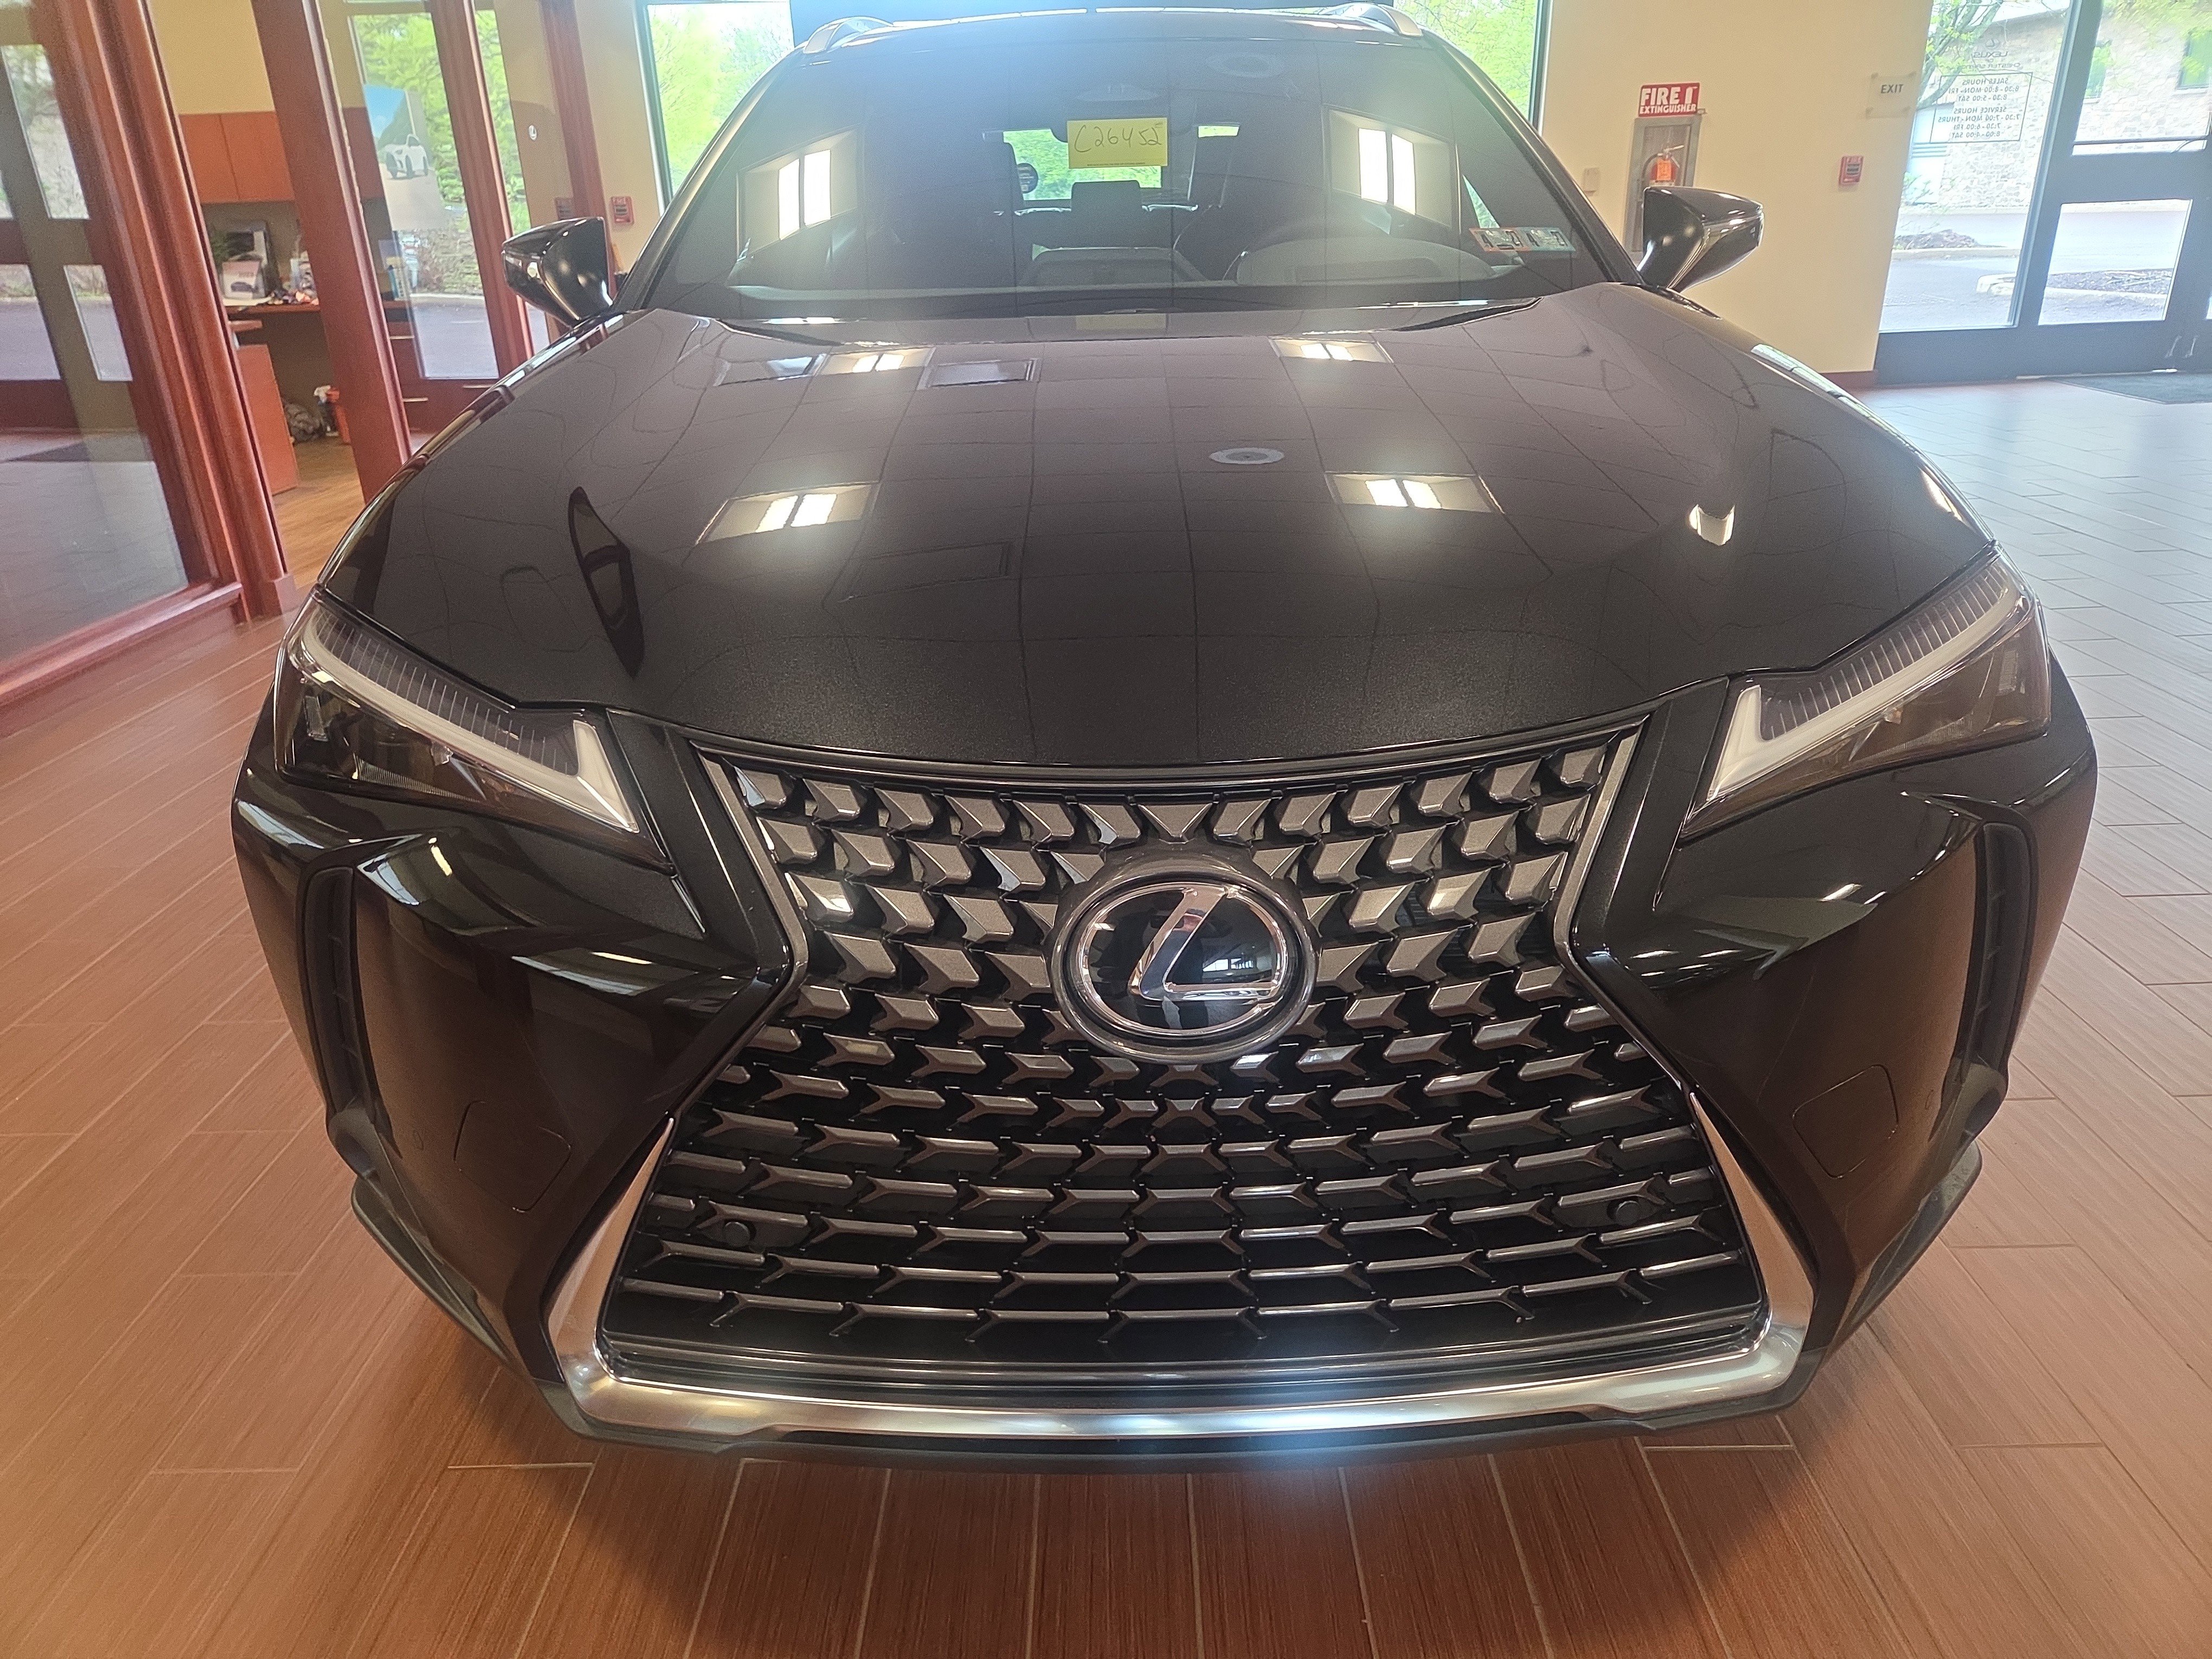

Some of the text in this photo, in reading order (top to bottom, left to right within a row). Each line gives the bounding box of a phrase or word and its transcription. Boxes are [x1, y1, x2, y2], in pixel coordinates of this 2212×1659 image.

[1881, 83, 1904, 94] EXIT
[1641, 87, 1681, 106] FIRE
[1639, 103, 1697, 114] EXTINGUISHER
[1074, 124, 1162, 153] C26452
